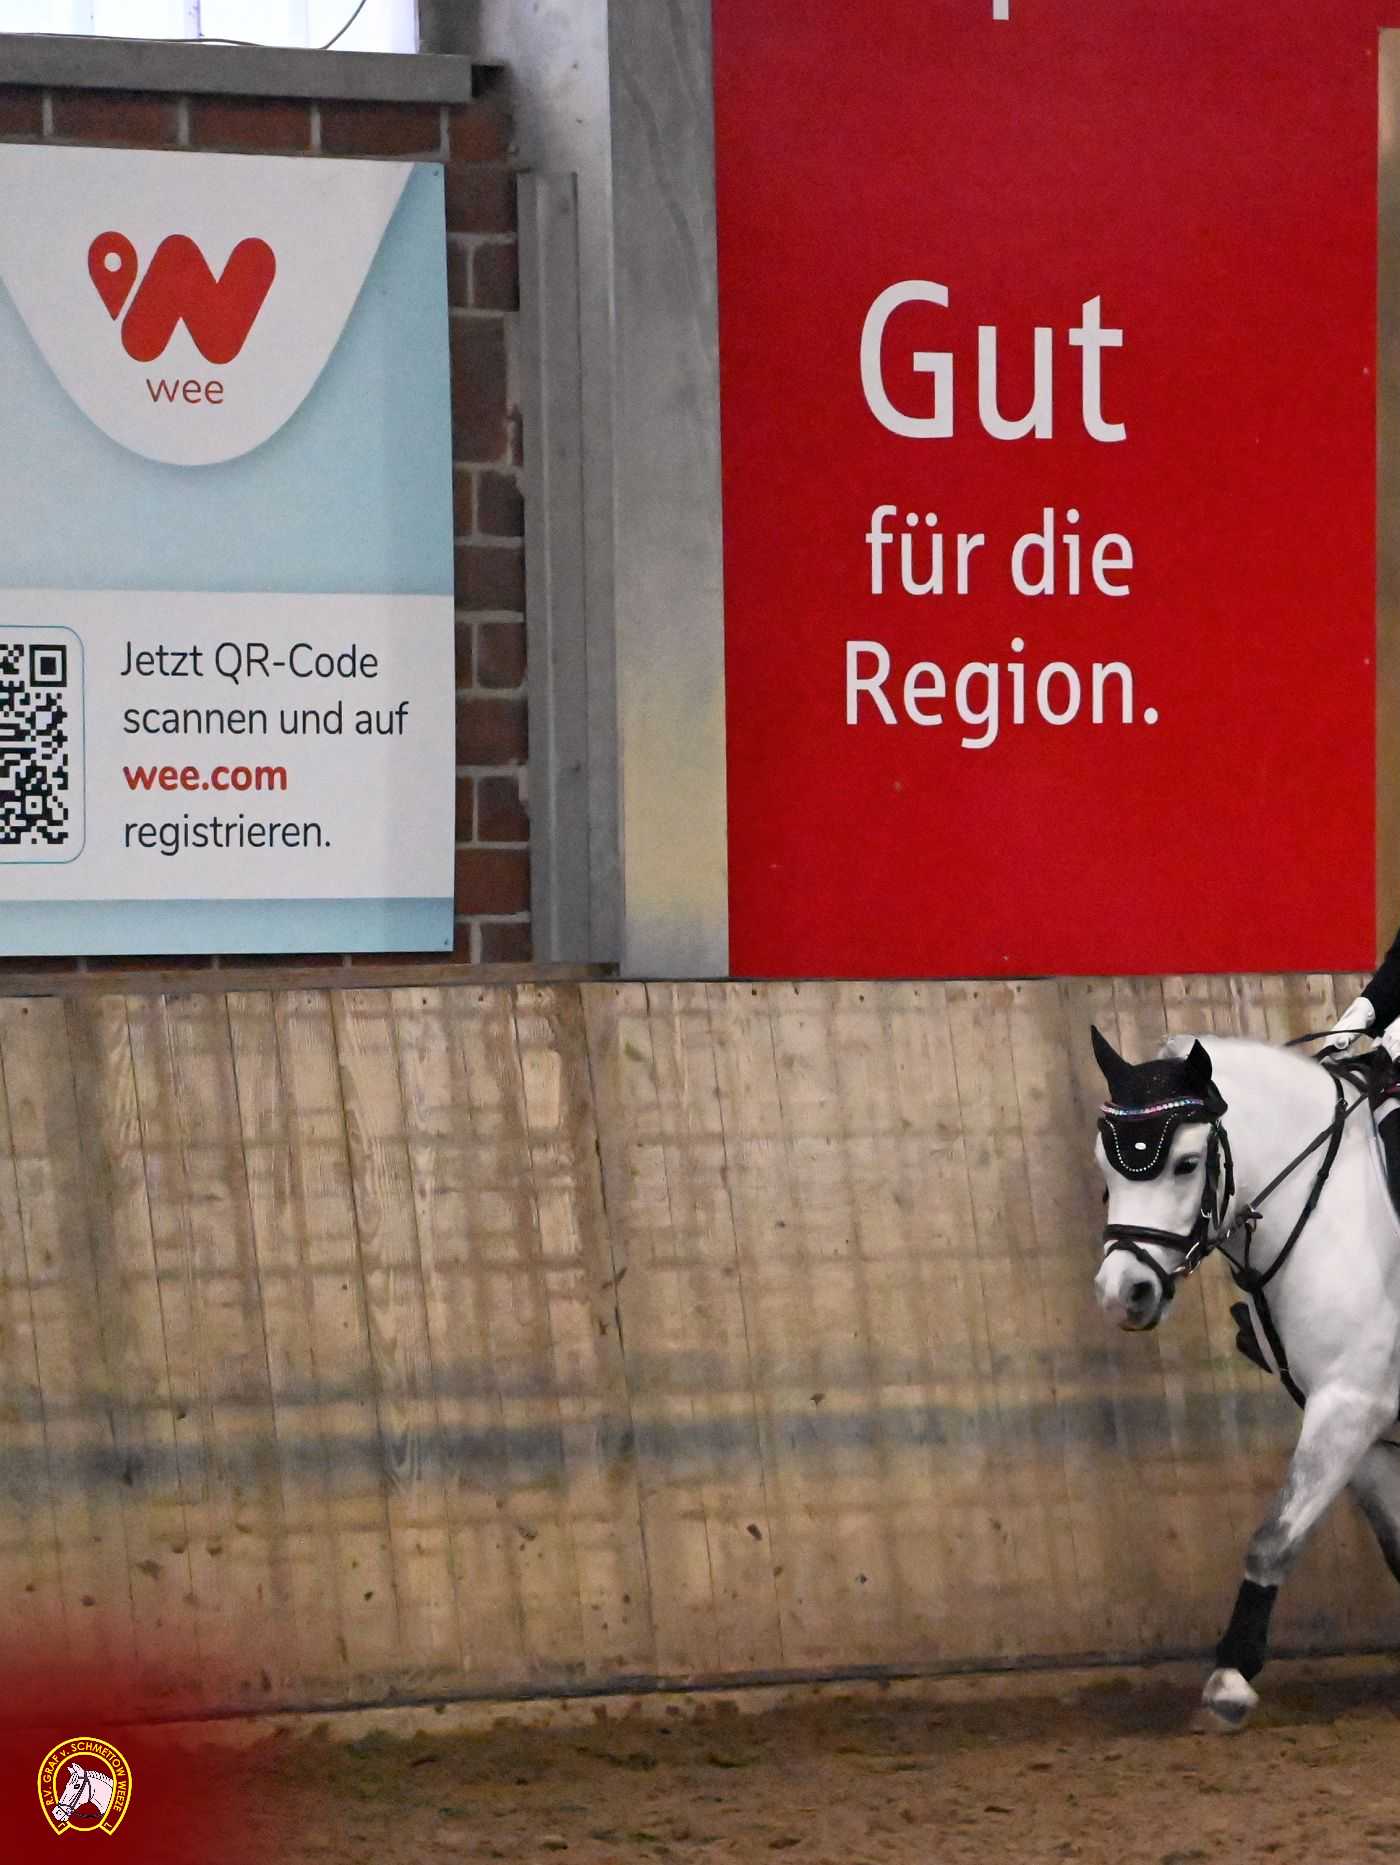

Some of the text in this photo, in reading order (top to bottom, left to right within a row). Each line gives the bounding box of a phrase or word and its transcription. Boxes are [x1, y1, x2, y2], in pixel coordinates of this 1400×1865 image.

[860, 280, 1127, 443] Gut
[146, 378, 225, 404] wee
[865, 504, 1133, 597] für die
[120, 641, 379, 685] Jetzt QR-Code
[846, 637, 1159, 749] Region.
[123, 700, 410, 735] scannen und auf
[122, 766, 288, 791] wee.com
[124, 813, 331, 856] registrieren.
